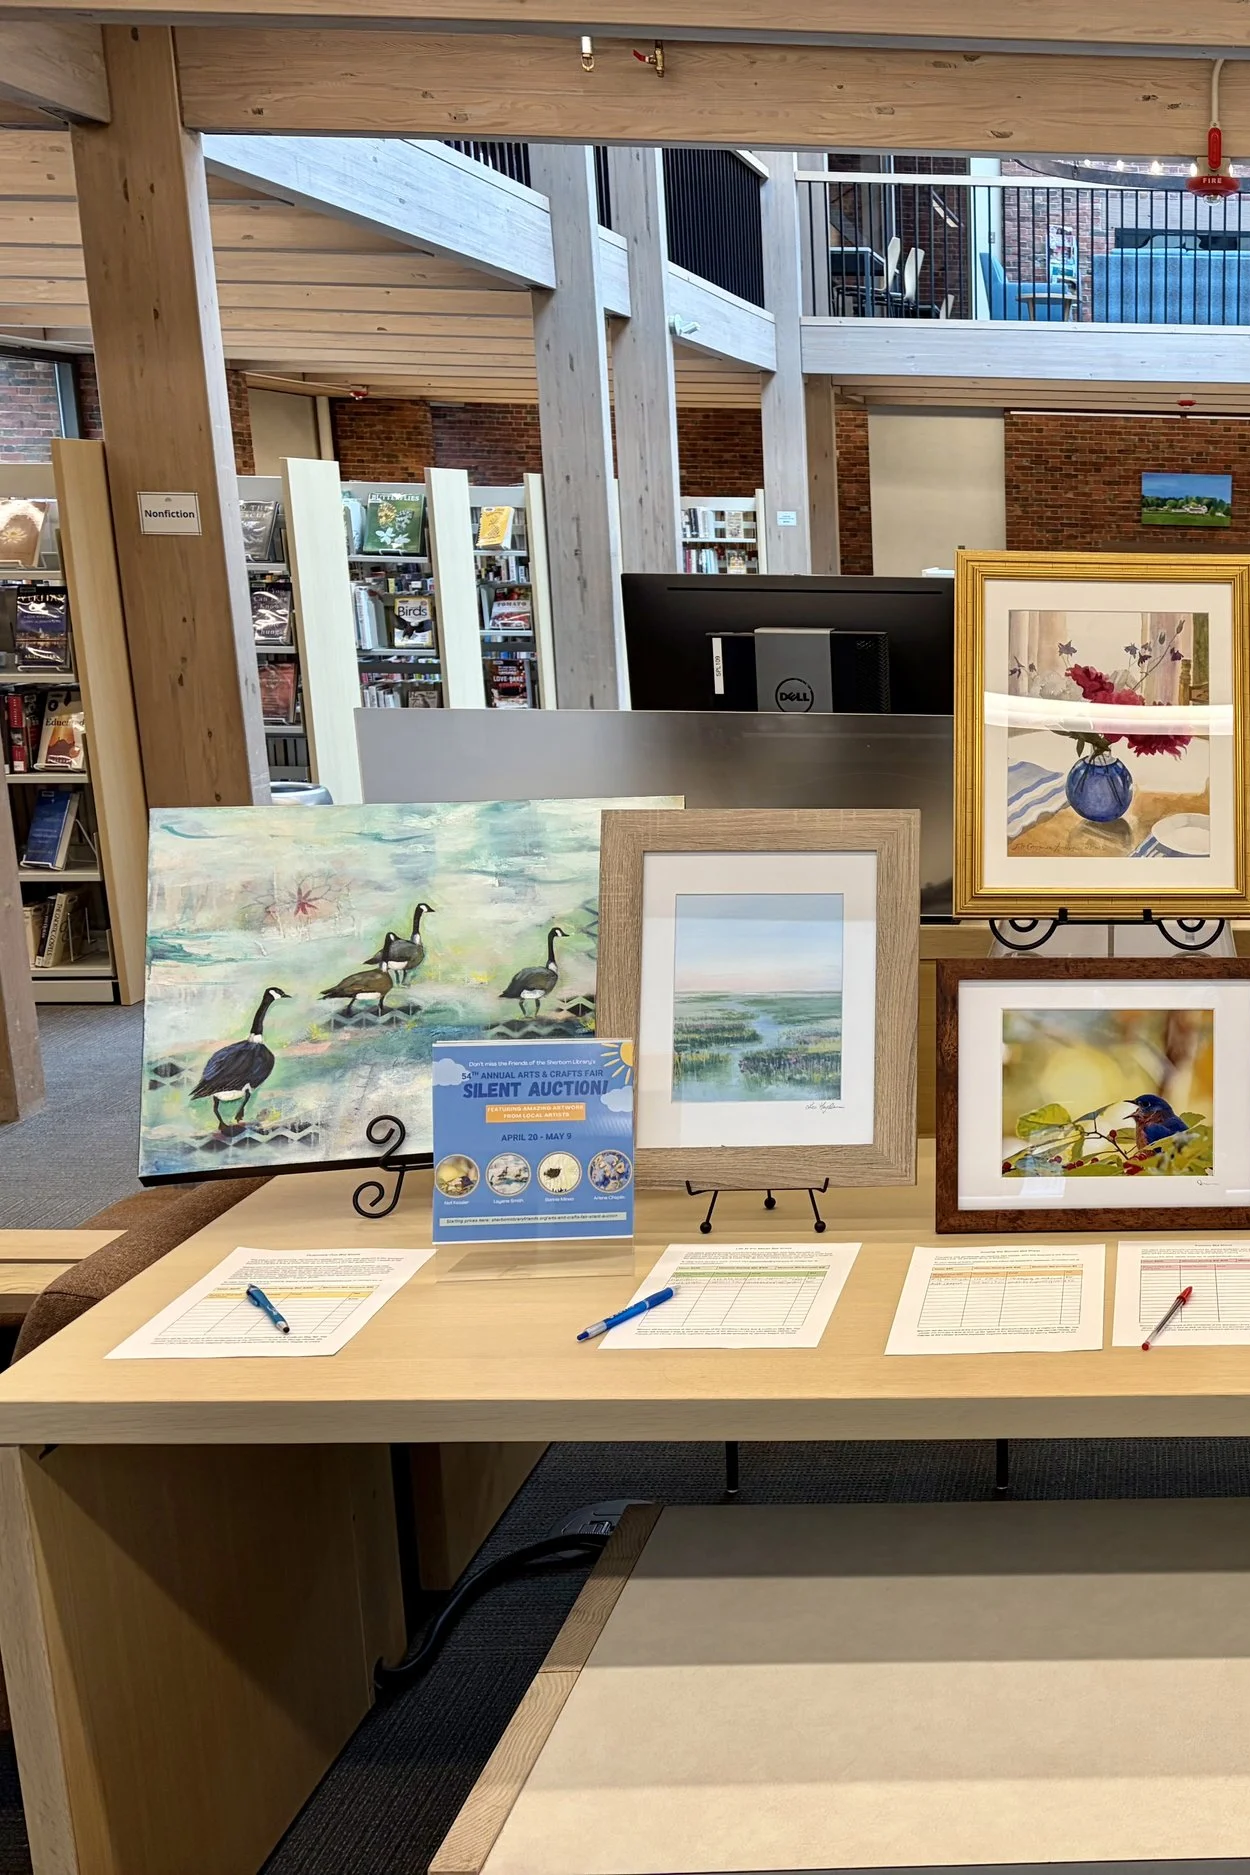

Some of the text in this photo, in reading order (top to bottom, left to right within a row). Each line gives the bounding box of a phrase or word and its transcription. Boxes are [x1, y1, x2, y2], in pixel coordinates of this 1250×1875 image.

[144, 509, 195, 518] Nonfiction
[397, 605, 427, 617] Birds
[779, 691, 810, 702] DELL
[46, 717, 85, 727] Educd
[481, 1071, 515, 1080] ANNUAL
[517, 1071, 540, 1079] ARTS
[541, 1070, 548, 1078] &
[550, 1070, 582, 1078] CRAFTS
[584, 1069, 604, 1077] FAIR
[463, 1080, 609, 1099] SILENT AUCTION!
[501, 1134, 526, 1142] APRIL
[528, 1133, 538, 1141] 20
[545, 1132, 565, 1140] MAY
[566, 1132, 572, 1140] 9
